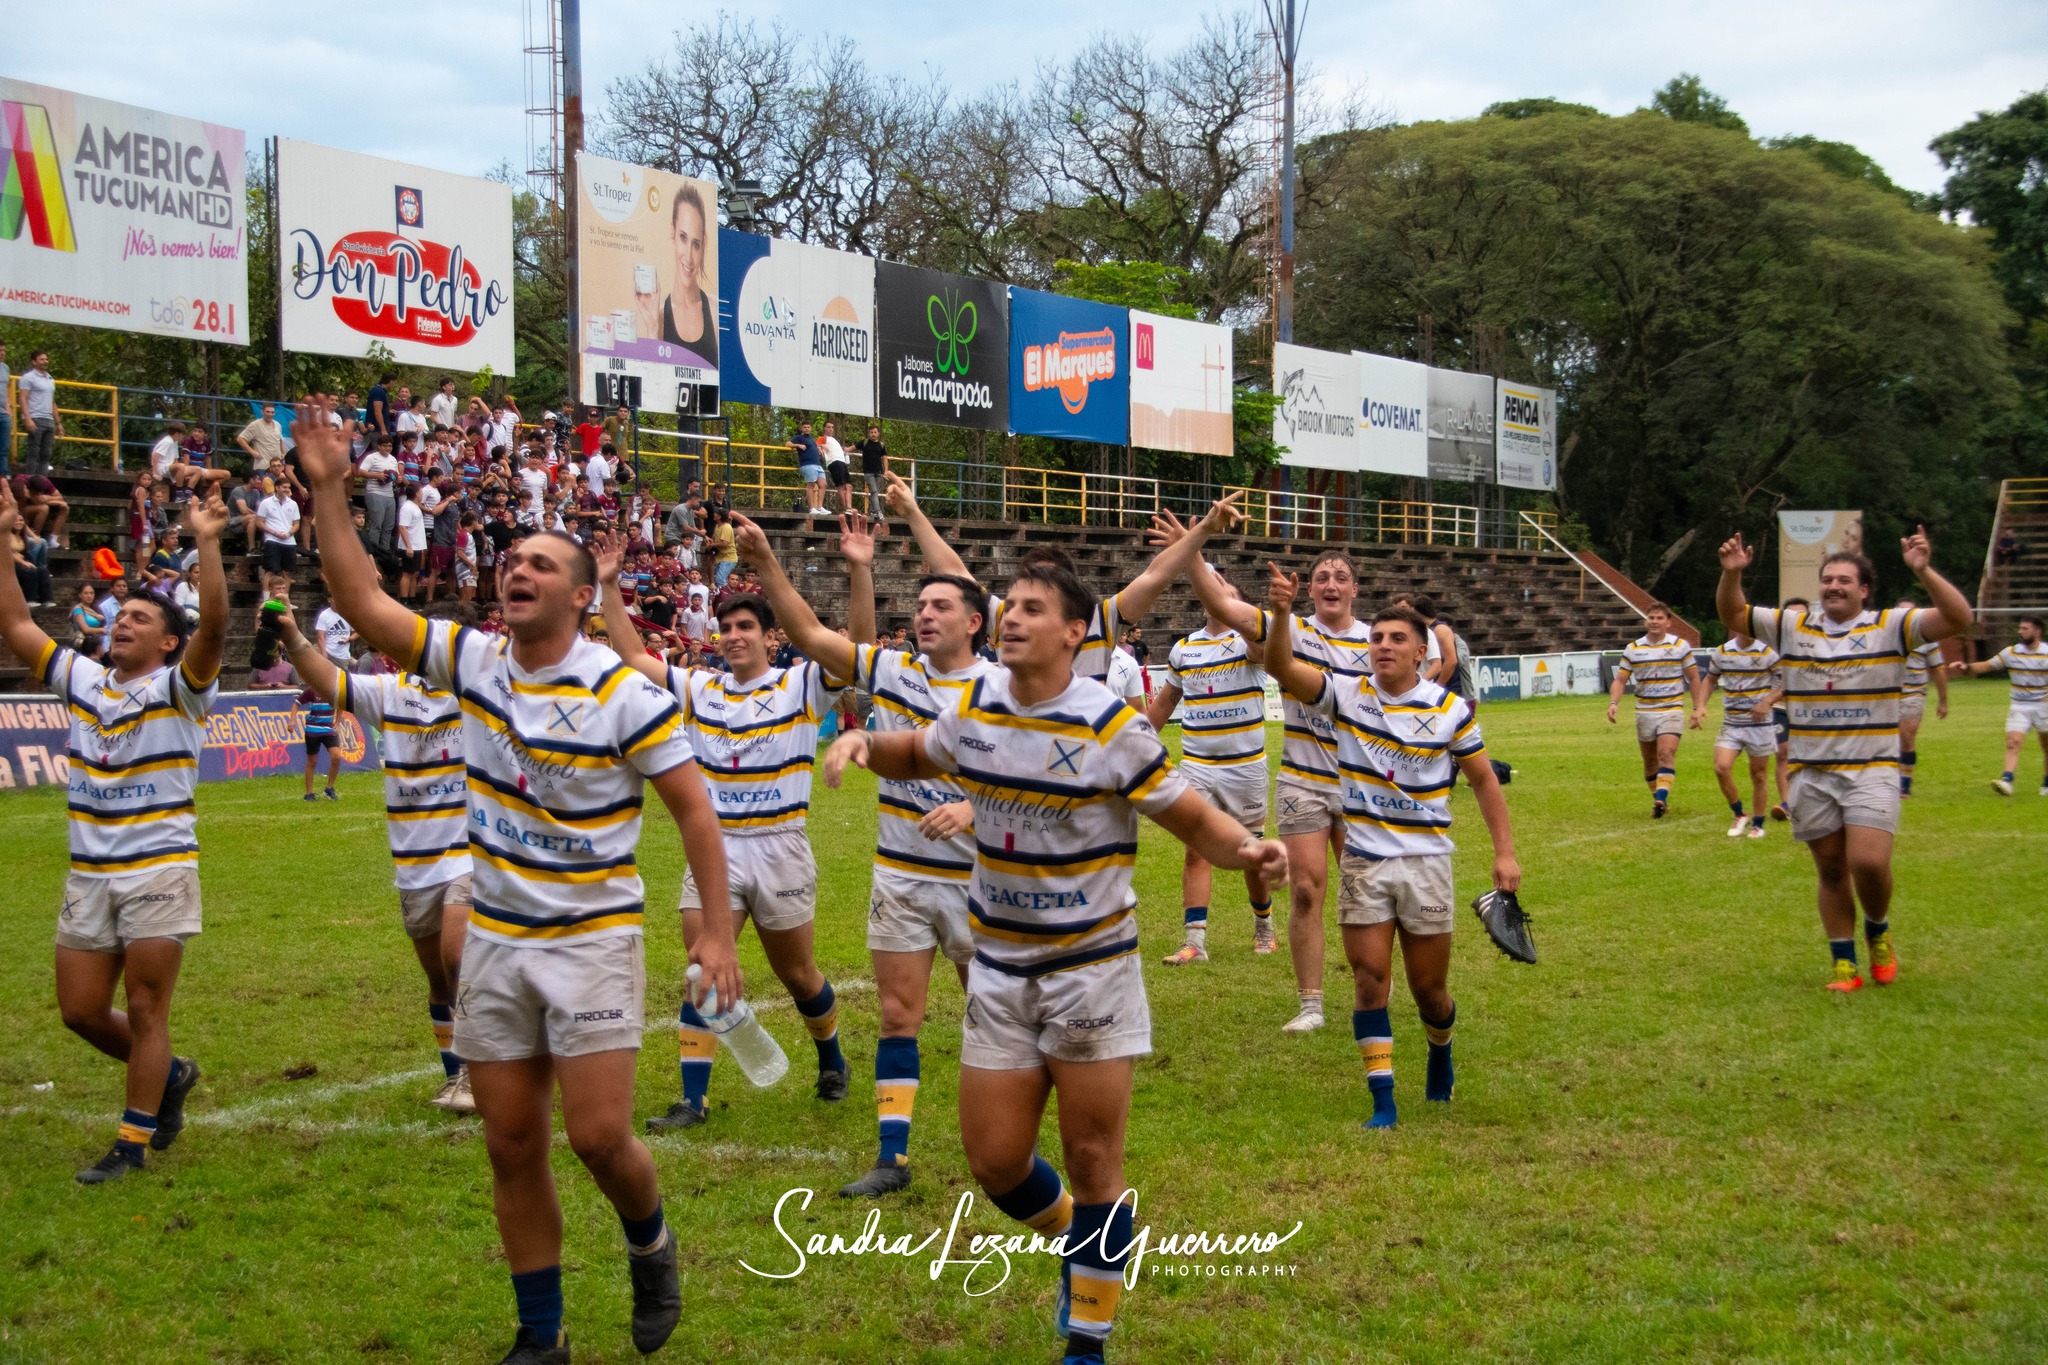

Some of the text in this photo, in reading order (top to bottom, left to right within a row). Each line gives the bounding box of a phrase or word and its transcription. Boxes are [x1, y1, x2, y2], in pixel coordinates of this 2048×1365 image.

[75, 123, 231, 193] AMERICA
[161, 239, 205, 258] vemos
[209, 226, 242, 260] bien!
[290, 228, 508, 328] Don Pedro
[745, 321, 796, 341] ADVANTA
[811, 321, 869, 363] AGROSEED
[1061, 334, 1113, 350] Supermercado
[609, 357, 626, 371] LOCAL
[674, 366, 702, 380] VISITANTE
[903, 354, 934, 374] Jabones
[1026, 347, 1114, 386] El Marques
[897, 360, 993, 417] la mariposa
[1370, 401, 1421, 432] COVEMAT
[1504, 395, 1539, 427] RENOA
[1298, 410, 1354, 438] BROOK MOTORS
[1183, 662, 1239, 681] Michelob
[1493, 667, 1519, 687] Macro
[898, 675, 929, 697] PROCER
[1196, 706, 1248, 720] GACETA
[1795, 707, 1871, 718] LA GACETA
[959, 735, 997, 754] PROCER
[1355, 735, 1434, 766] Michelob
[224, 738, 290, 778] Deportes
[398, 786, 422, 797] LA
[718, 788, 783, 803] GACETA
[1348, 787, 1367, 802] LA
[970, 783, 1073, 823] Michelob
[980, 813, 1051, 833] ULTRA
[496, 817, 598, 856] GACETA
[986, 885, 1090, 910] GACETA
[1420, 905, 1448, 913] PROCER
[574, 1008, 624, 1023] PROCER
[1066, 1015, 1115, 1030] PROCER
